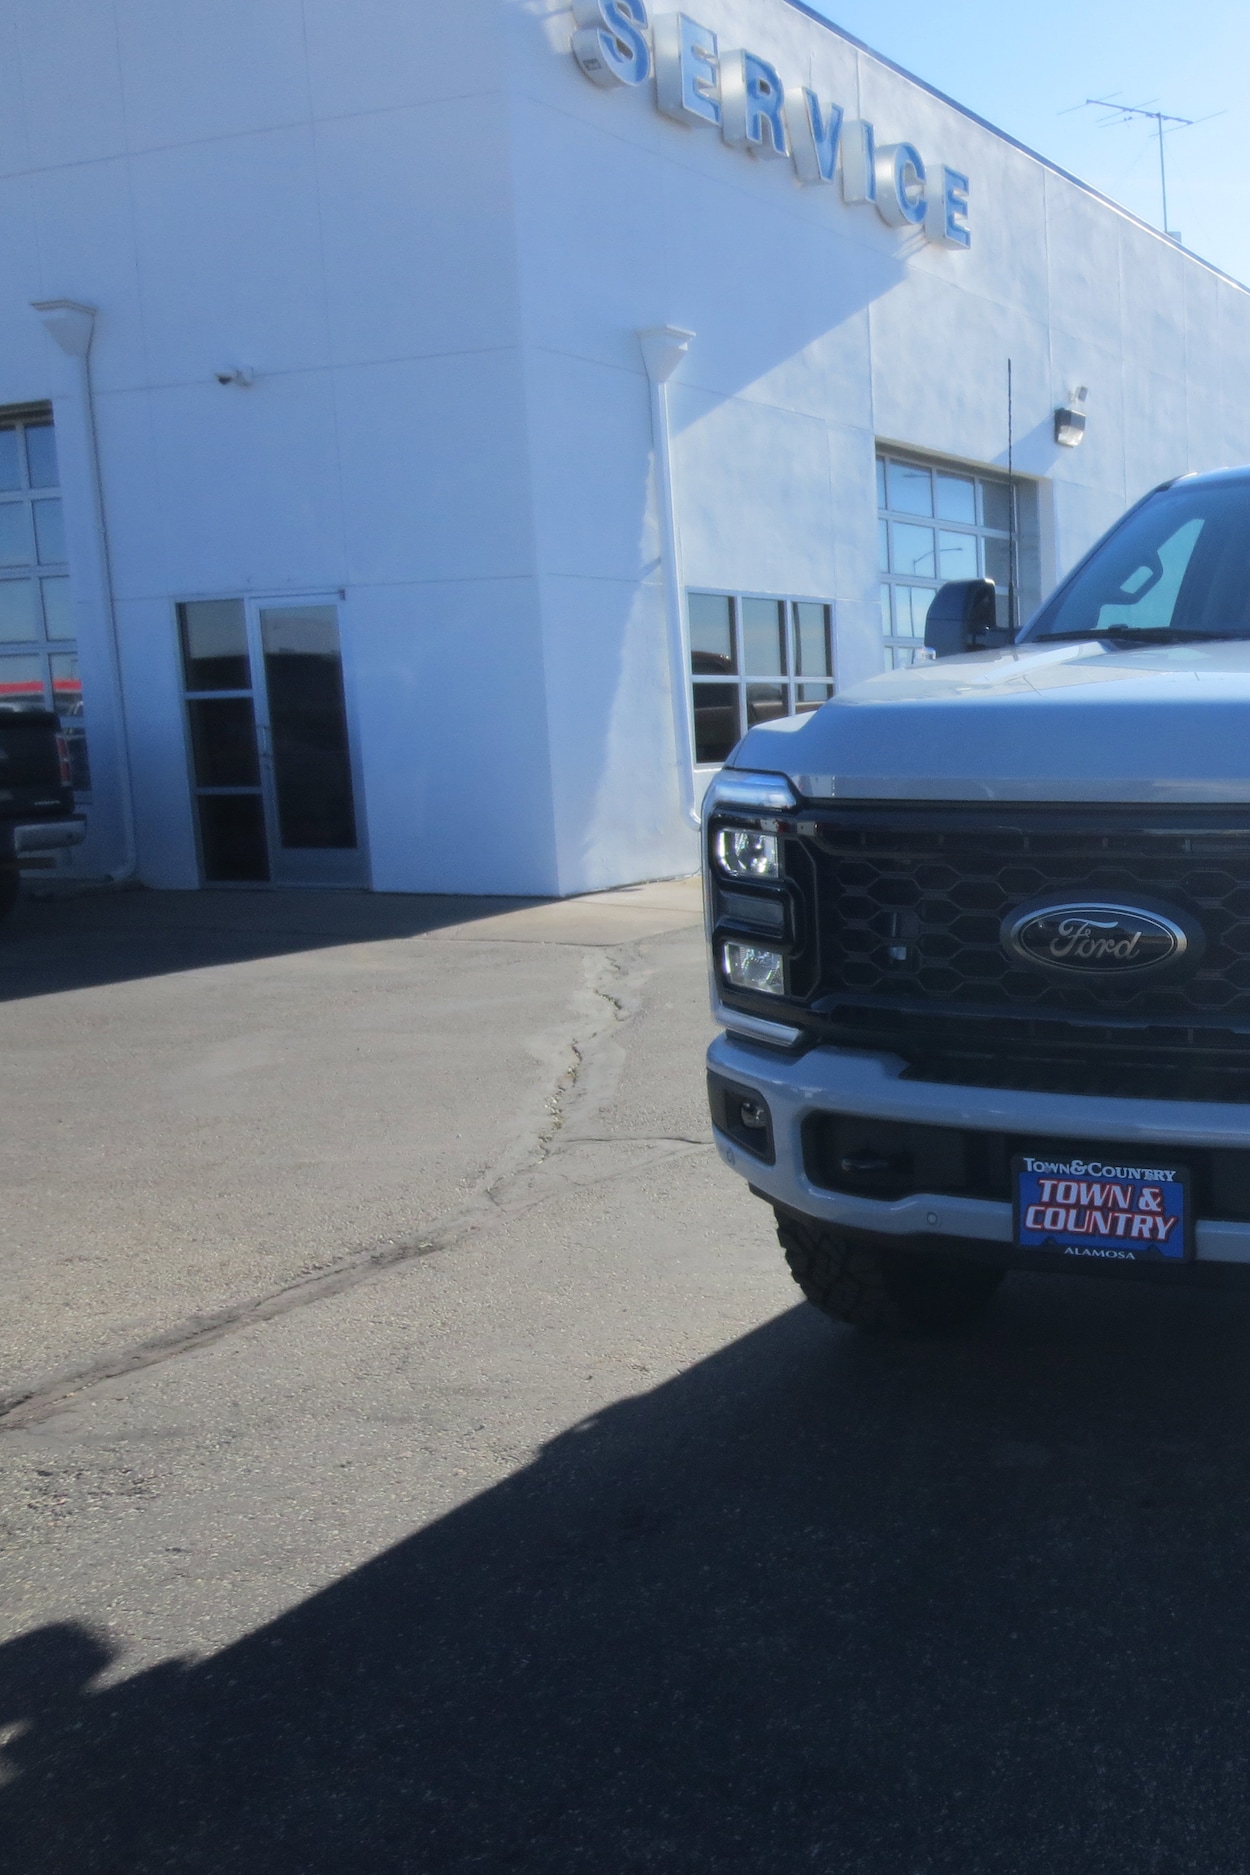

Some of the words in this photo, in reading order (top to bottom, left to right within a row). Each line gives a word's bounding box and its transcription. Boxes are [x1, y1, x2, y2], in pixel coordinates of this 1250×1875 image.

[571, 0, 971, 250] SERVICE
[1050, 917, 1142, 960] Ford
[1038, 1179, 1132, 1210] TOWN
[1138, 1187, 1163, 1213] &
[1025, 1205, 1178, 1240] COUNTRY
[1064, 1246, 1136, 1261] ALAMOSA
